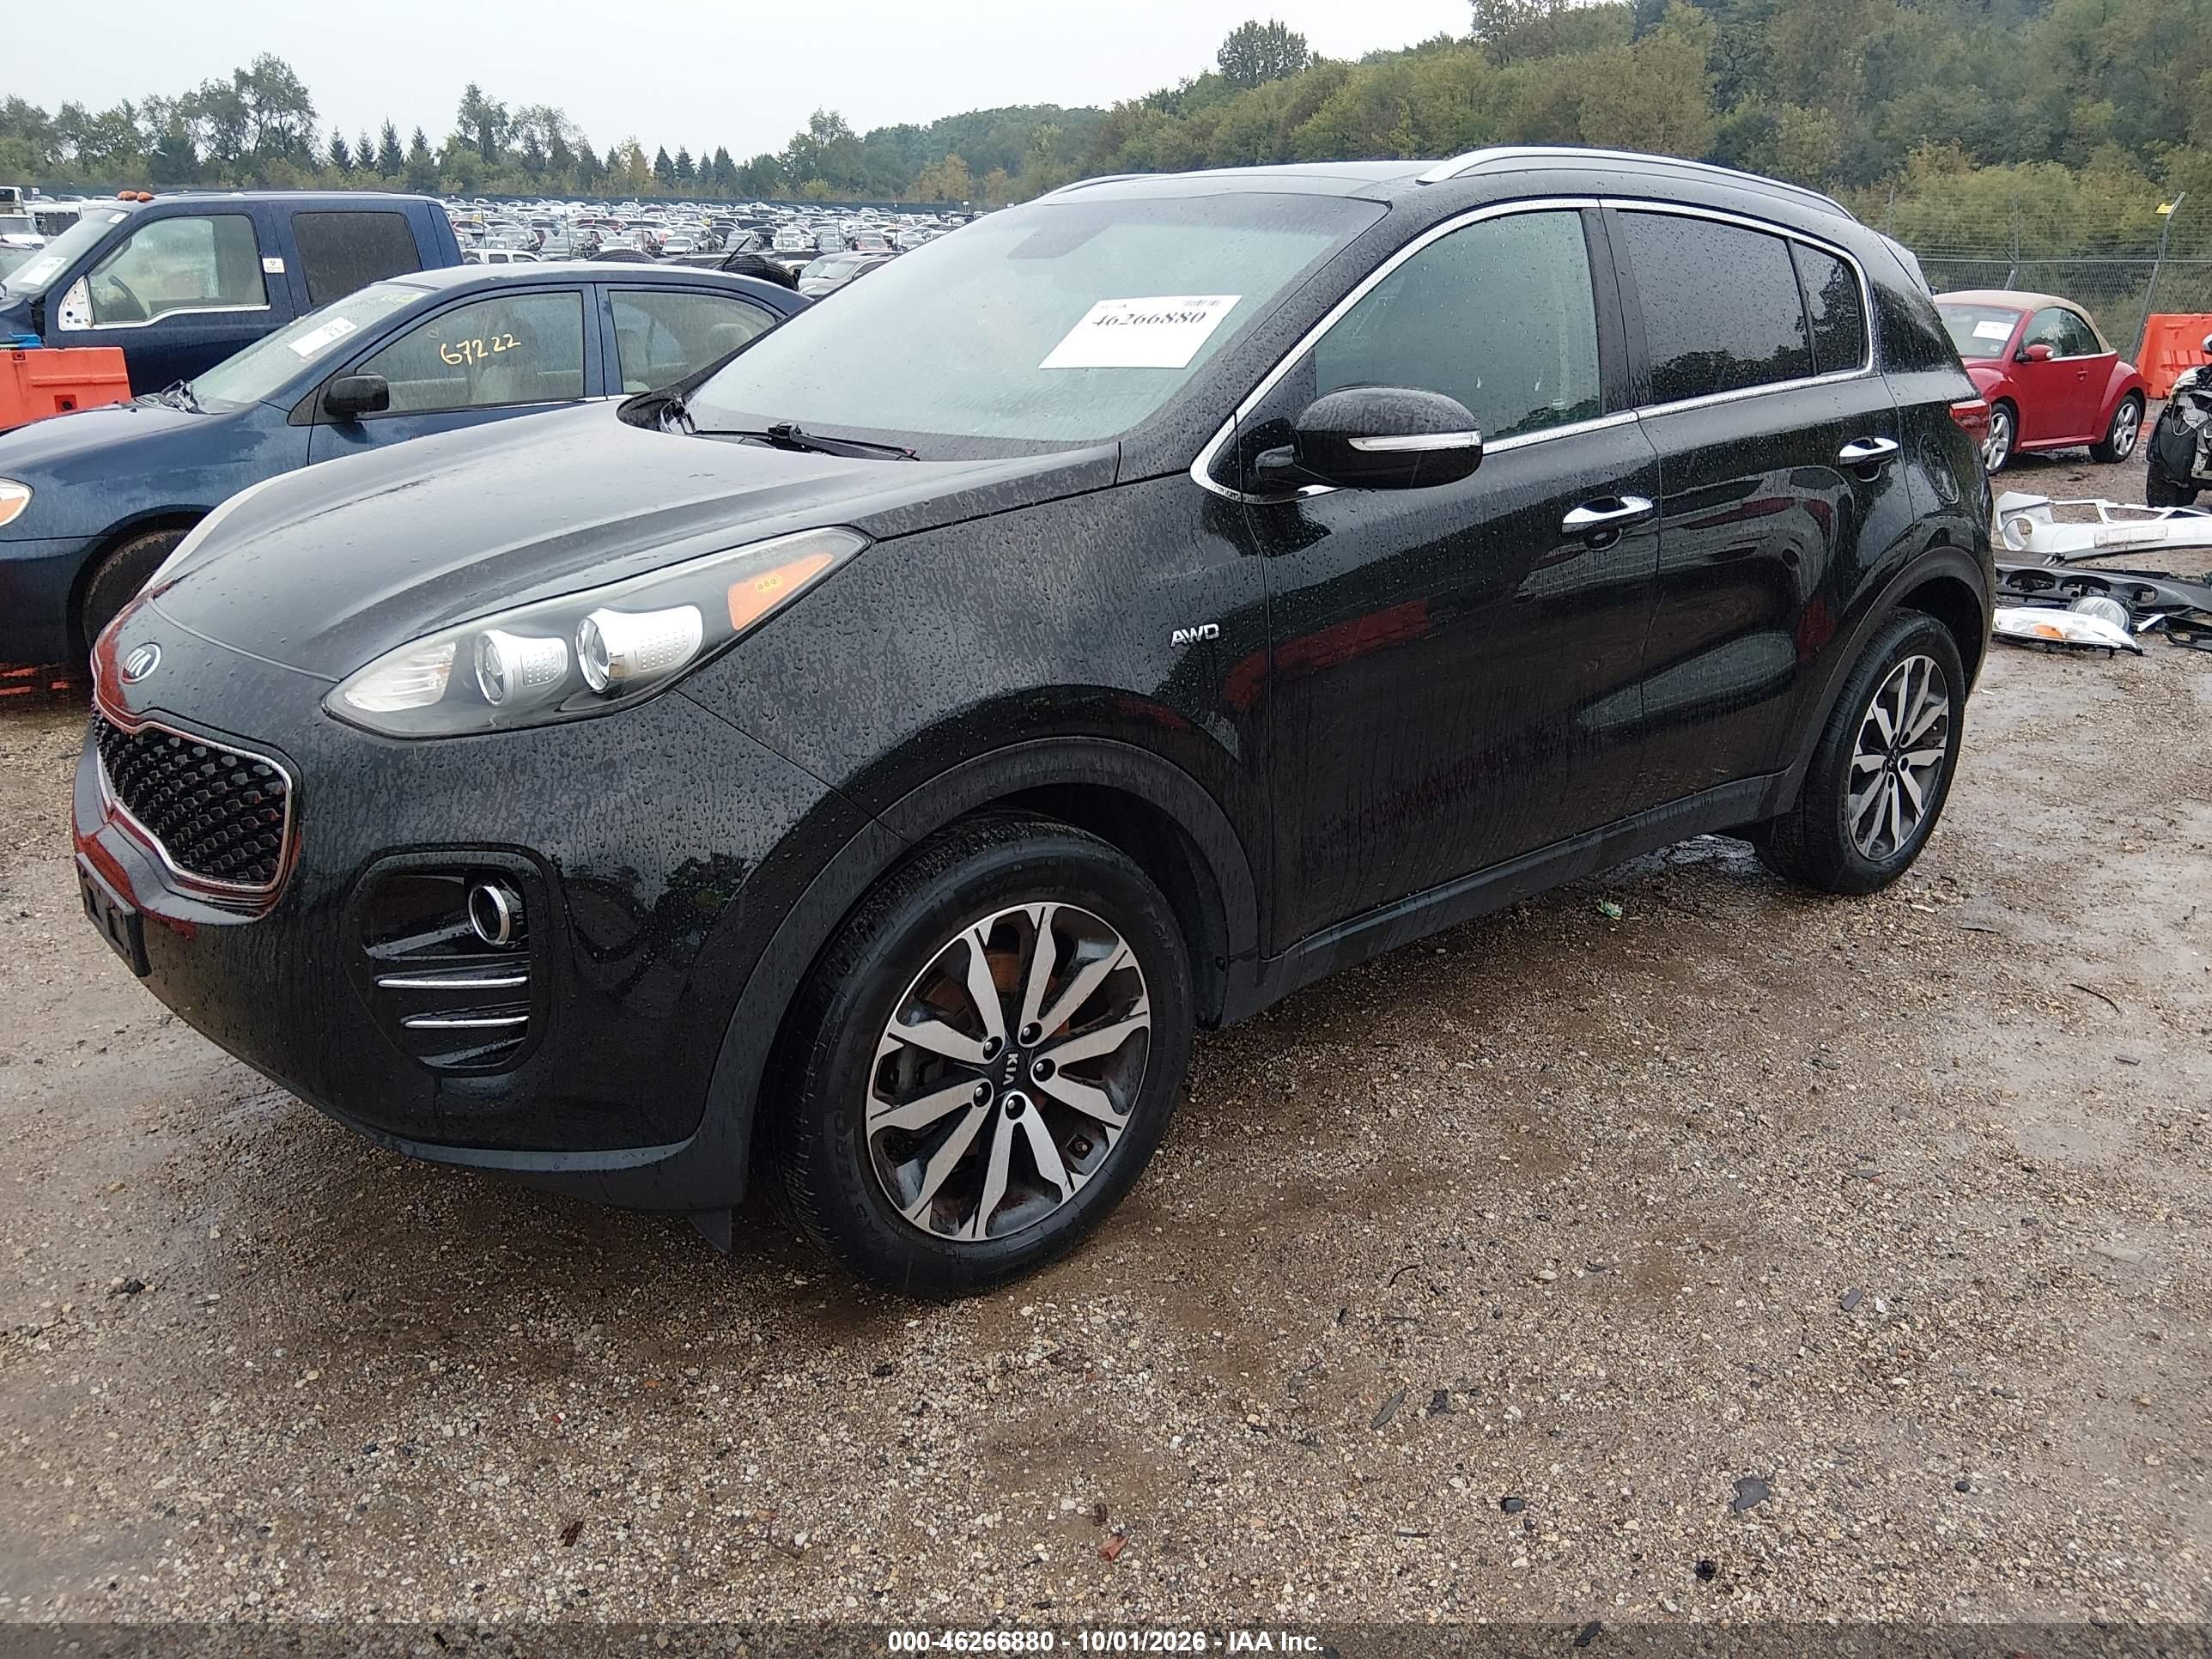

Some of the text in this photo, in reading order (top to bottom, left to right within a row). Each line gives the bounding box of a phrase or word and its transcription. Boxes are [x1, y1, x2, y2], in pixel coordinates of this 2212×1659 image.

[1091, 311, 1207, 326] 46266880
[440, 333, 522, 366] 67222
[1170, 623, 1219, 647] AWD
[1002, 1053, 1019, 1086] KIA
